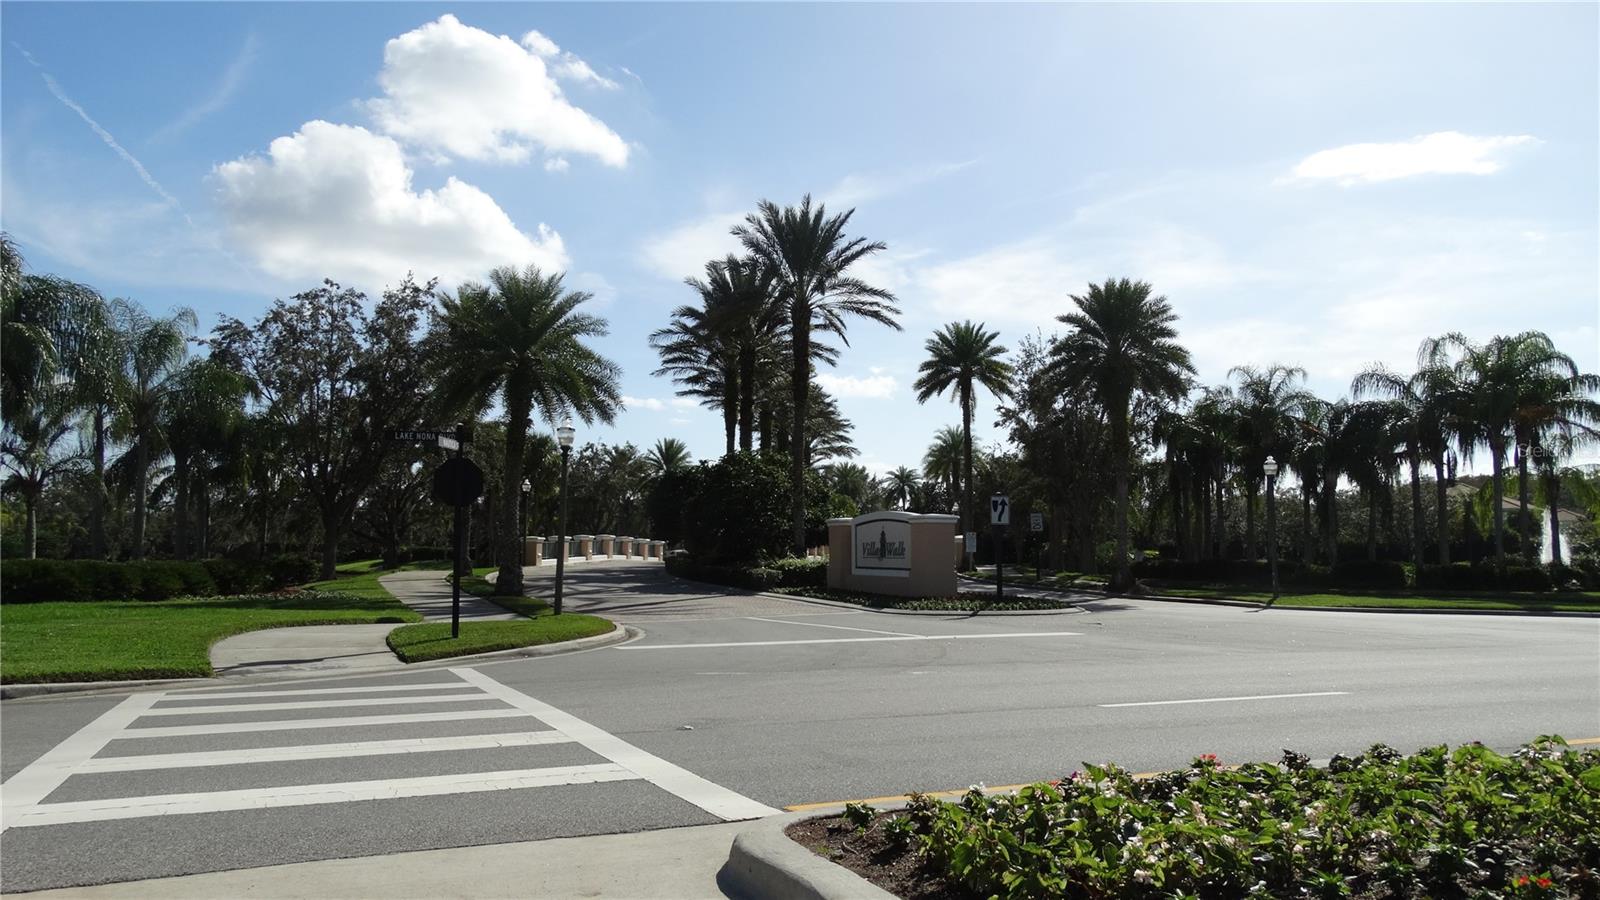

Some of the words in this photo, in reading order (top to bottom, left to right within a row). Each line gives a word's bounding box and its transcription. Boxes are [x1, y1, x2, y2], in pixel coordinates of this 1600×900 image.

[394, 432, 414, 440] LAKE
[416, 432, 436, 441] NONA
[886, 541, 906, 556] Walk
